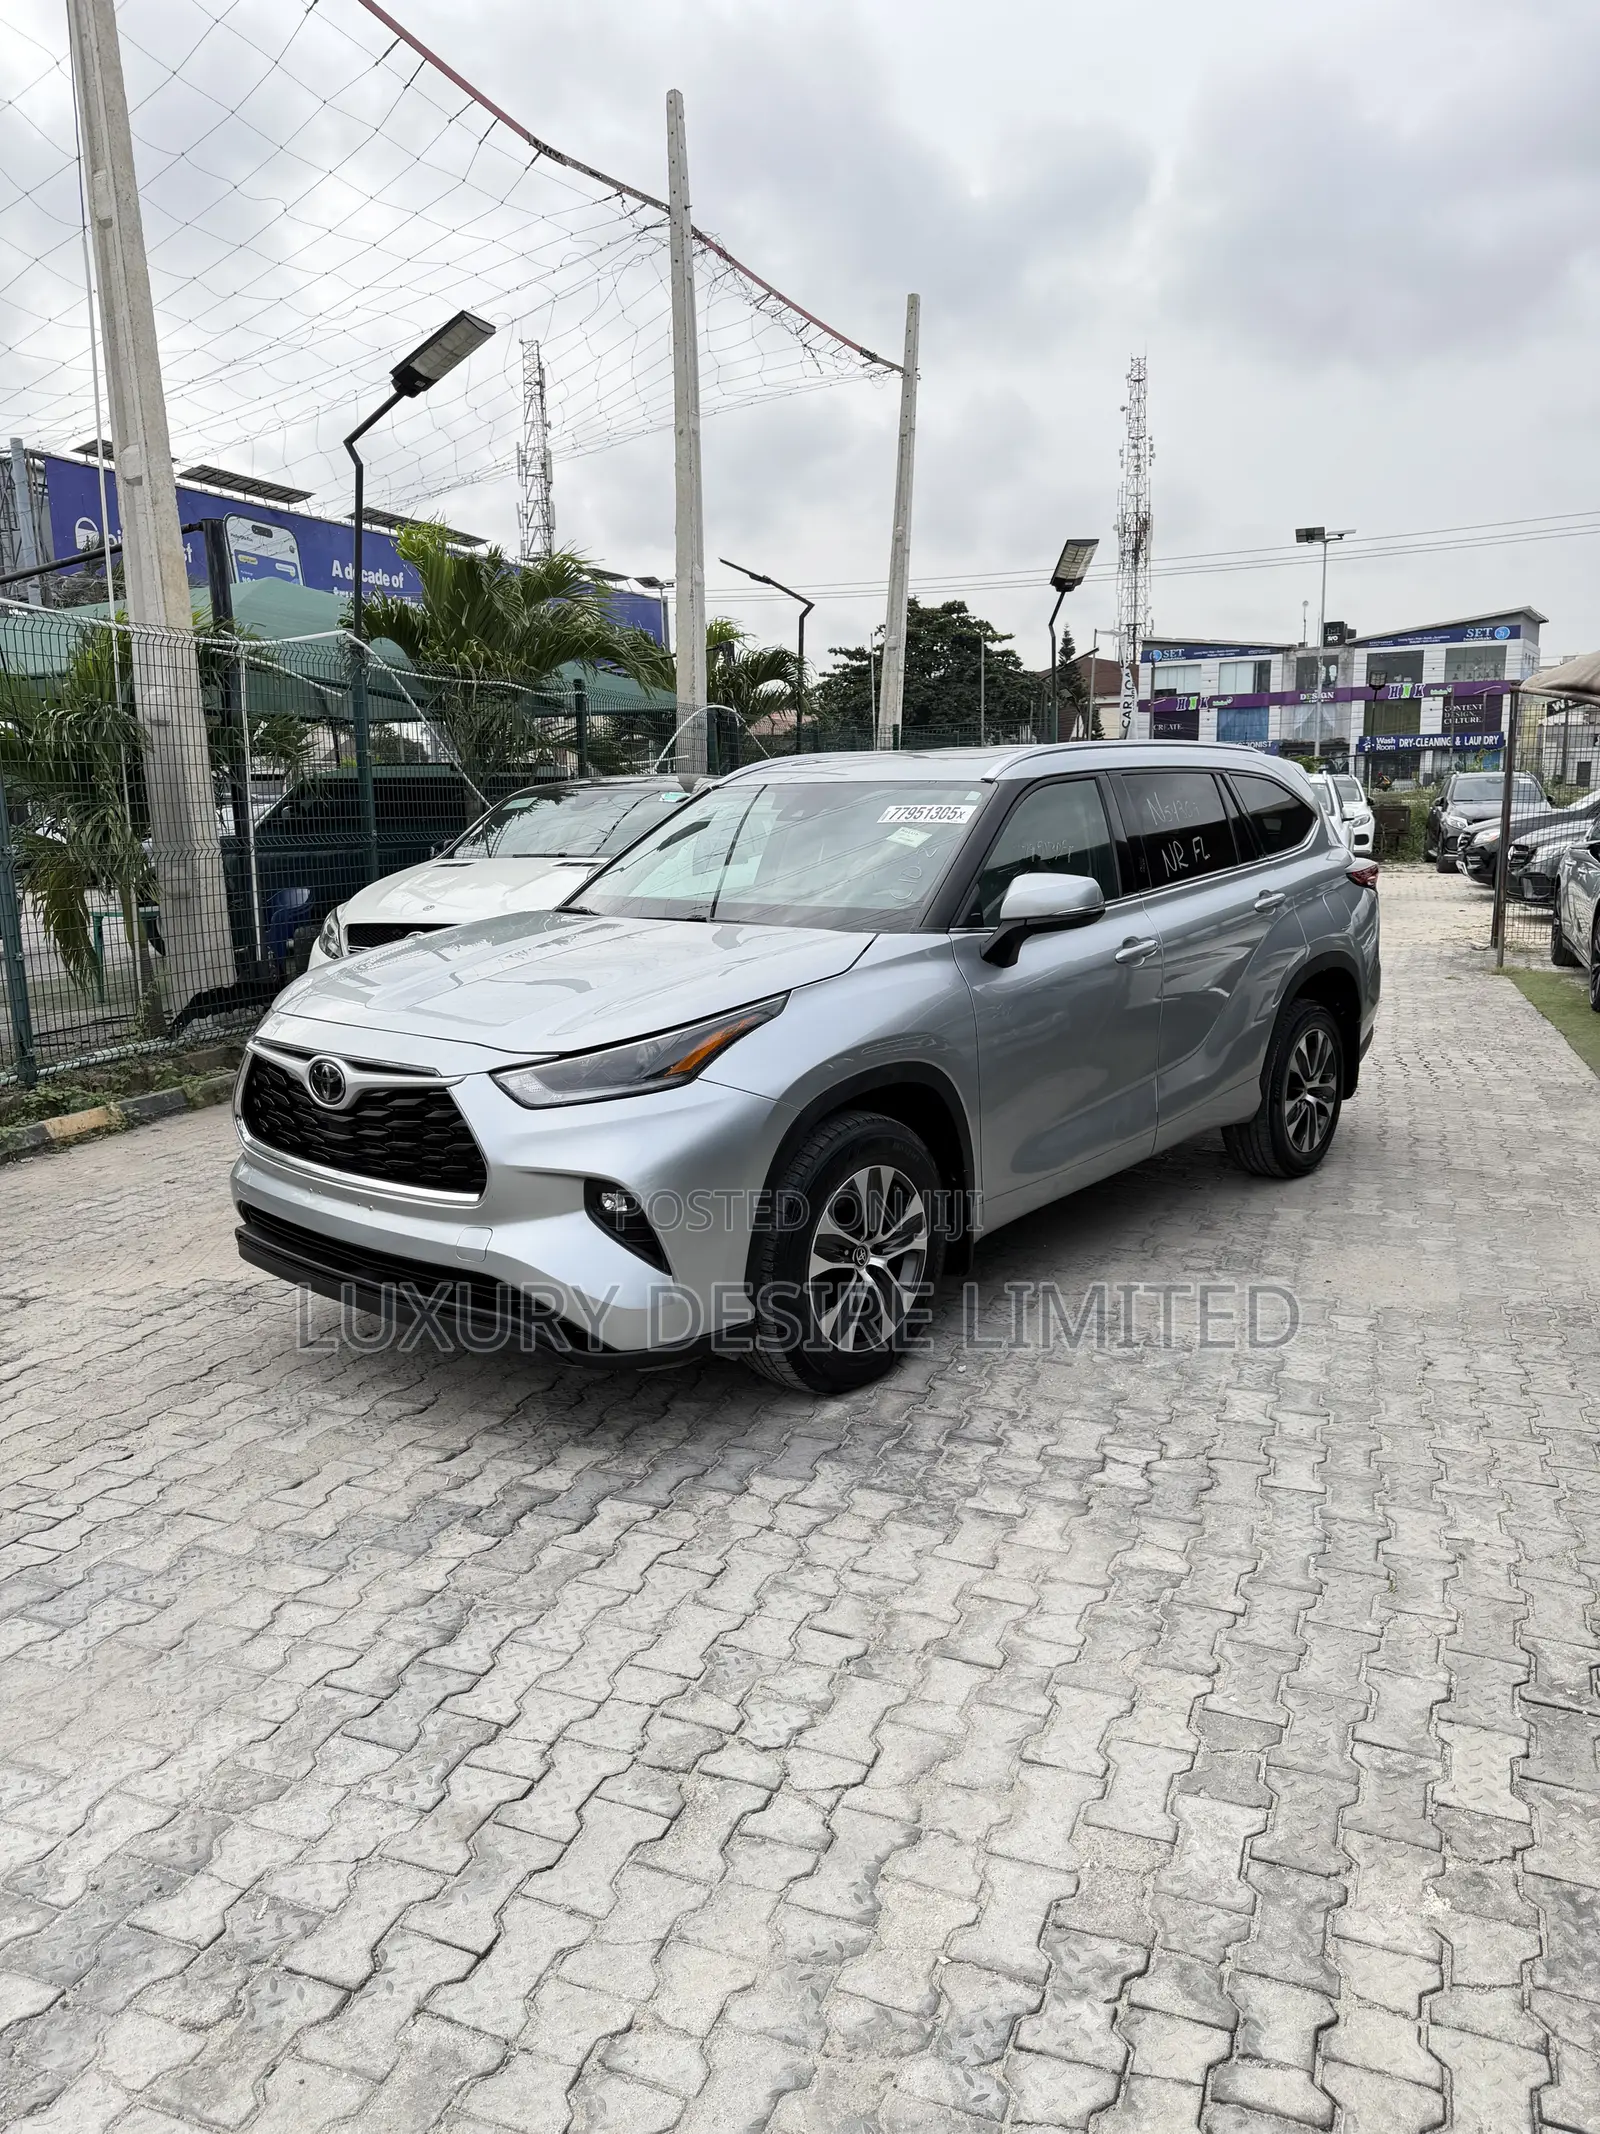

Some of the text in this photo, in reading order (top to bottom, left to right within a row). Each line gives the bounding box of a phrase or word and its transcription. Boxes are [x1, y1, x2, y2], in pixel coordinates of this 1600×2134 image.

[331, 559, 404, 588] A dcade of
[1466, 627, 1493, 638] SET
[1163, 648, 1185, 658] SET
[1300, 692, 1335, 701] DESGN
[1122, 701, 1133, 729] CAR
[1399, 737, 1452, 748] DRY-CLEANING
[1455, 736, 1461, 746] &
[1161, 836, 1211, 877] NR FL
